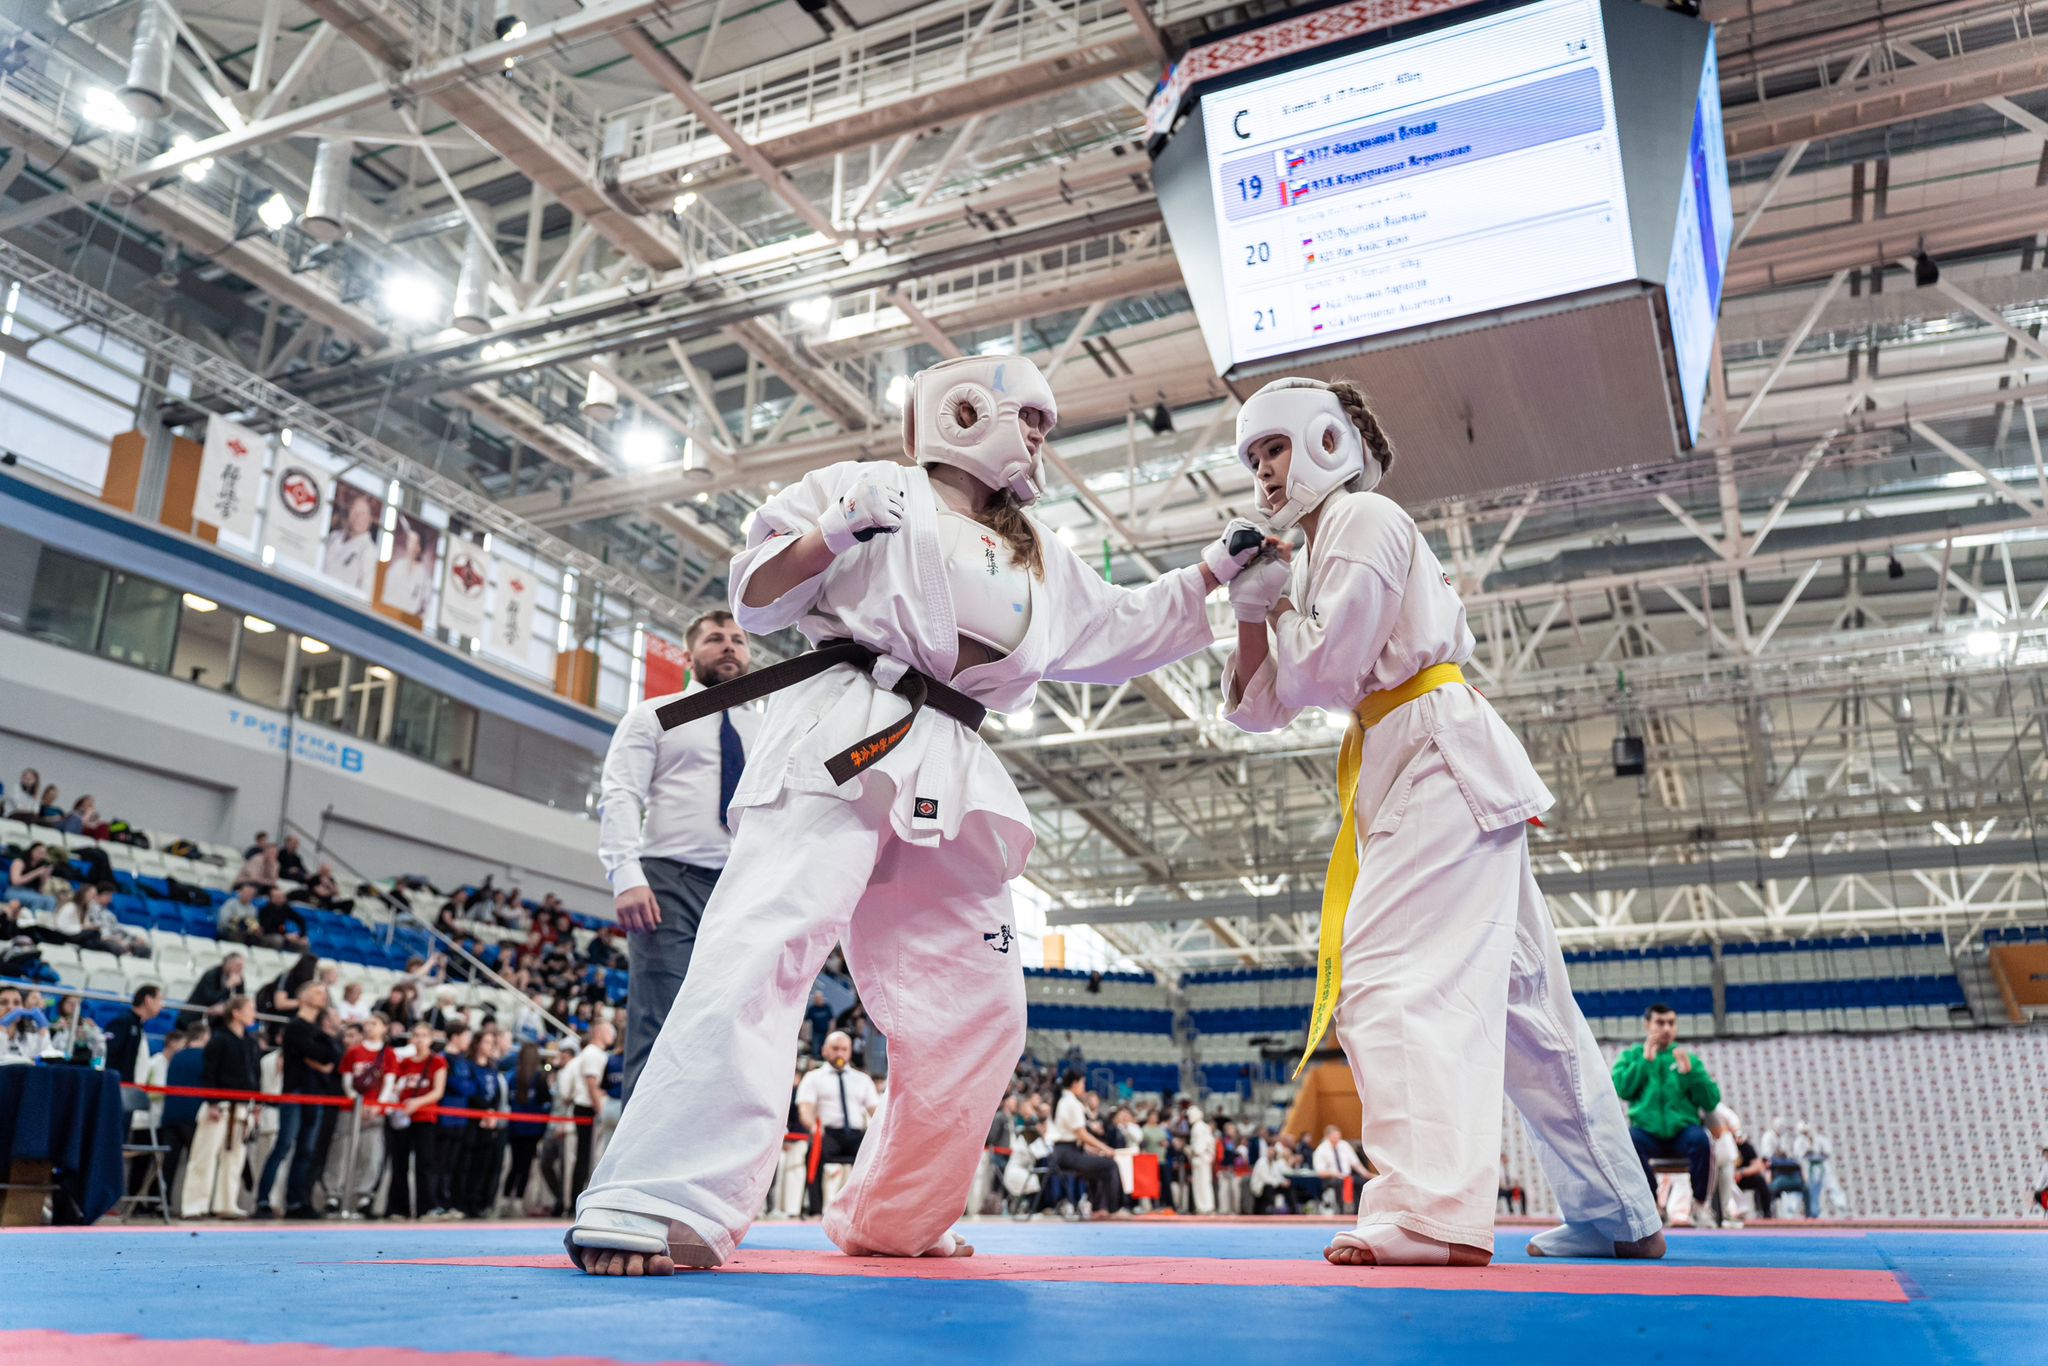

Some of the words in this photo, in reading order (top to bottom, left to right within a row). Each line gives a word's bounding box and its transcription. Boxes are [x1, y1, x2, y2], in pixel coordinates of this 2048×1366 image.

[1234, 109, 1250, 140] C
[1237, 175, 1263, 201] 19
[1246, 241, 1270, 266] 20
[1254, 308, 1277, 331] 21
